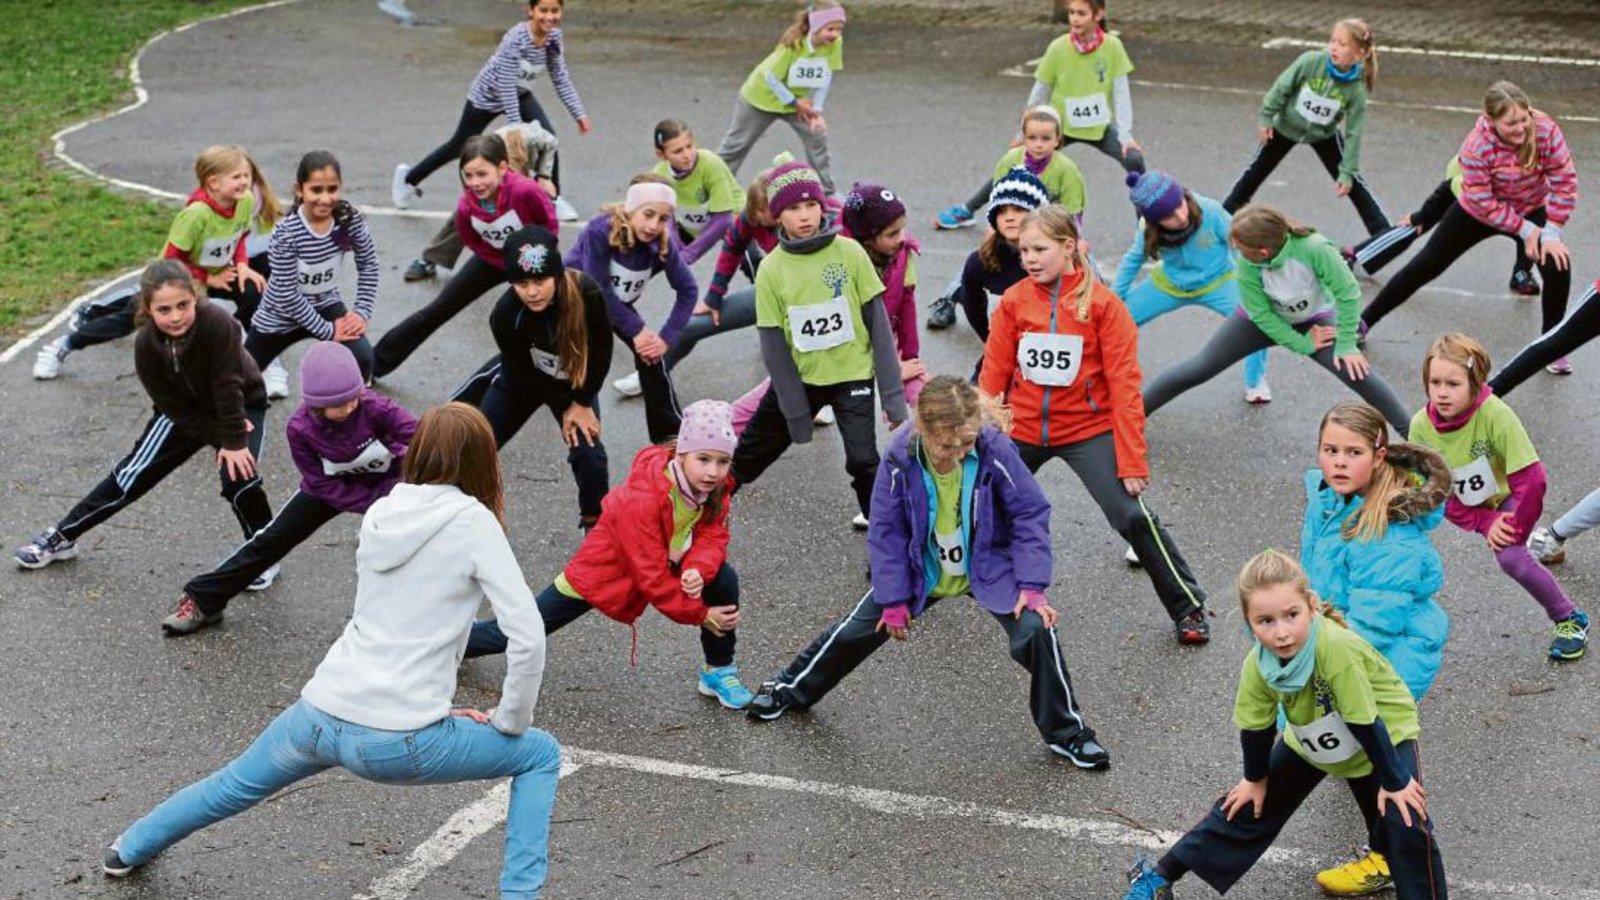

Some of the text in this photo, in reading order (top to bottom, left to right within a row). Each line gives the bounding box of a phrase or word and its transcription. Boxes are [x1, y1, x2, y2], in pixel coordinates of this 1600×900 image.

[797, 67, 823, 79] 382
[1073, 105, 1100, 118] 441
[1303, 101, 1332, 117] 443
[298, 268, 334, 286] 385
[801, 313, 843, 337] 423
[1026, 348, 1071, 370] 395
[1455, 474, 1486, 495] 78
[1302, 732, 1341, 752] 16
